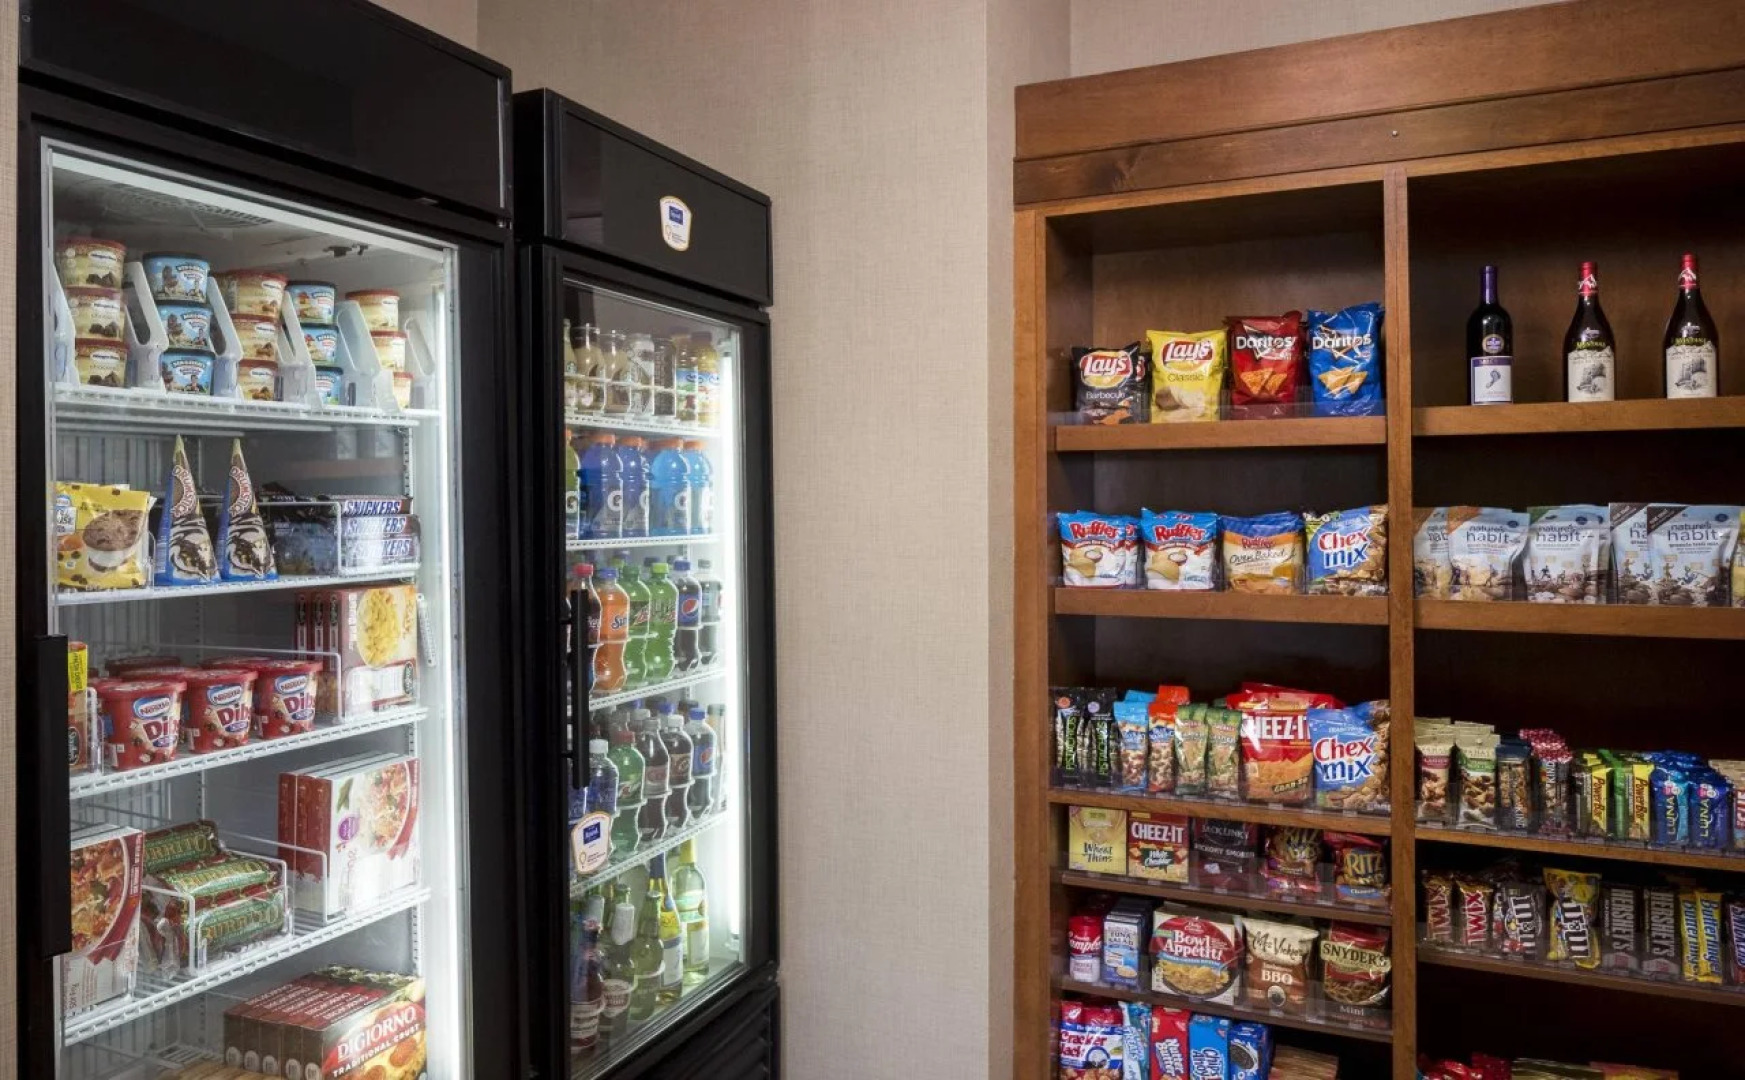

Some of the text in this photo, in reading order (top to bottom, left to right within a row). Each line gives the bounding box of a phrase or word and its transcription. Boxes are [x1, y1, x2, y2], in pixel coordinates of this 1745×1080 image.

[1236, 335, 1294, 350] Doritos
[1312, 333, 1372, 350] Doritos
[1167, 373, 1205, 383] Classic
[1085, 391, 1126, 401] Barbecue
[344, 499, 402, 516] SNICKERS
[1069, 520, 1119, 540] Ruffles
[1153, 523, 1206, 542] Ruffles
[1317, 528, 1371, 551] Chex
[1466, 531, 1510, 544] habit
[1536, 531, 1581, 543] habit
[1667, 530, 1719, 542] habit
[1323, 543, 1369, 569] mix
[1313, 735, 1376, 763] Chex
[1316, 756, 1374, 782] mix
[1666, 795, 1676, 836] LUNA
[1699, 798, 1711, 838] LUNA
[1131, 821, 1184, 844] CHEEZ-IT
[1347, 852, 1383, 875] RITZ
[1466, 891, 1488, 948] TWIX
[1610, 888, 1635, 952] HERSHEY'S
[1650, 891, 1675, 957] HERSHEY'S
[1172, 929, 1210, 947] Bowl
[1700, 898, 1720, 974] Butterfinger
[1323, 944, 1388, 968] SNYDER'S
[1261, 969, 1294, 986] BBQ
[1340, 1005, 1366, 1017] Mini
[393, 1023, 421, 1044] CRUST
[1060, 1030, 1108, 1047] Cracker
[1155, 1041, 1177, 1077] Butter
[1164, 1038, 1185, 1075] Nutter
